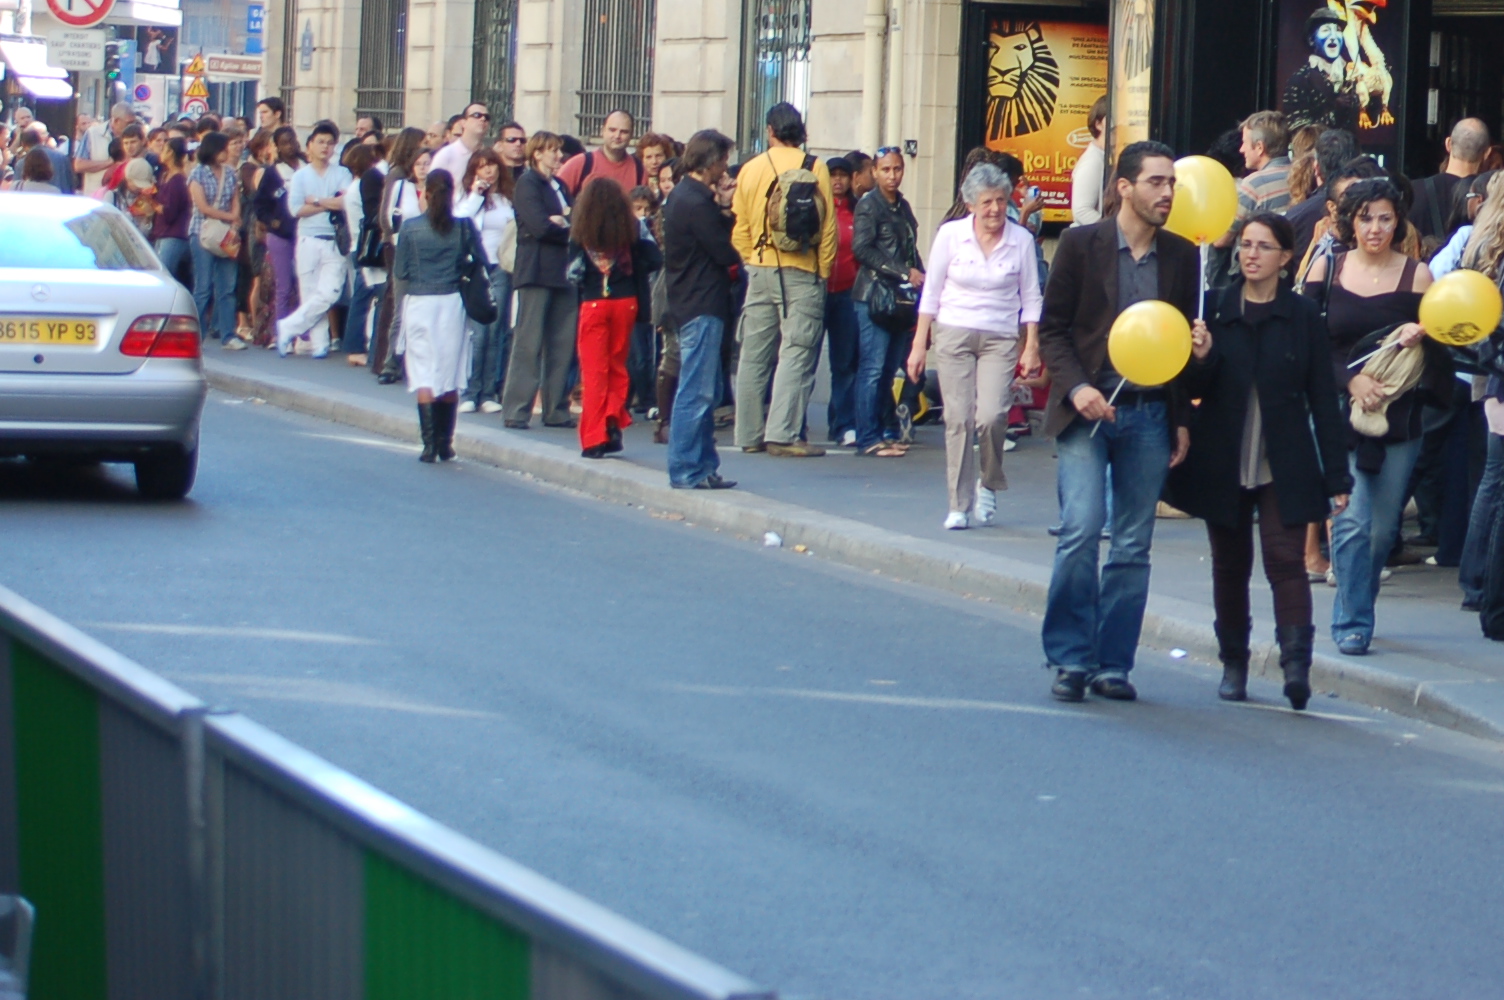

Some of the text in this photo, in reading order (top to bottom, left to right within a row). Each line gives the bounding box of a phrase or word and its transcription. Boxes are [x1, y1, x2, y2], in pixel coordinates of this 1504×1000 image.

[190, 105, 204, 115] 30
[1023, 149, 1051, 173] ROI
[48, 323, 68, 339] YP
[75, 323, 96, 341] 93
